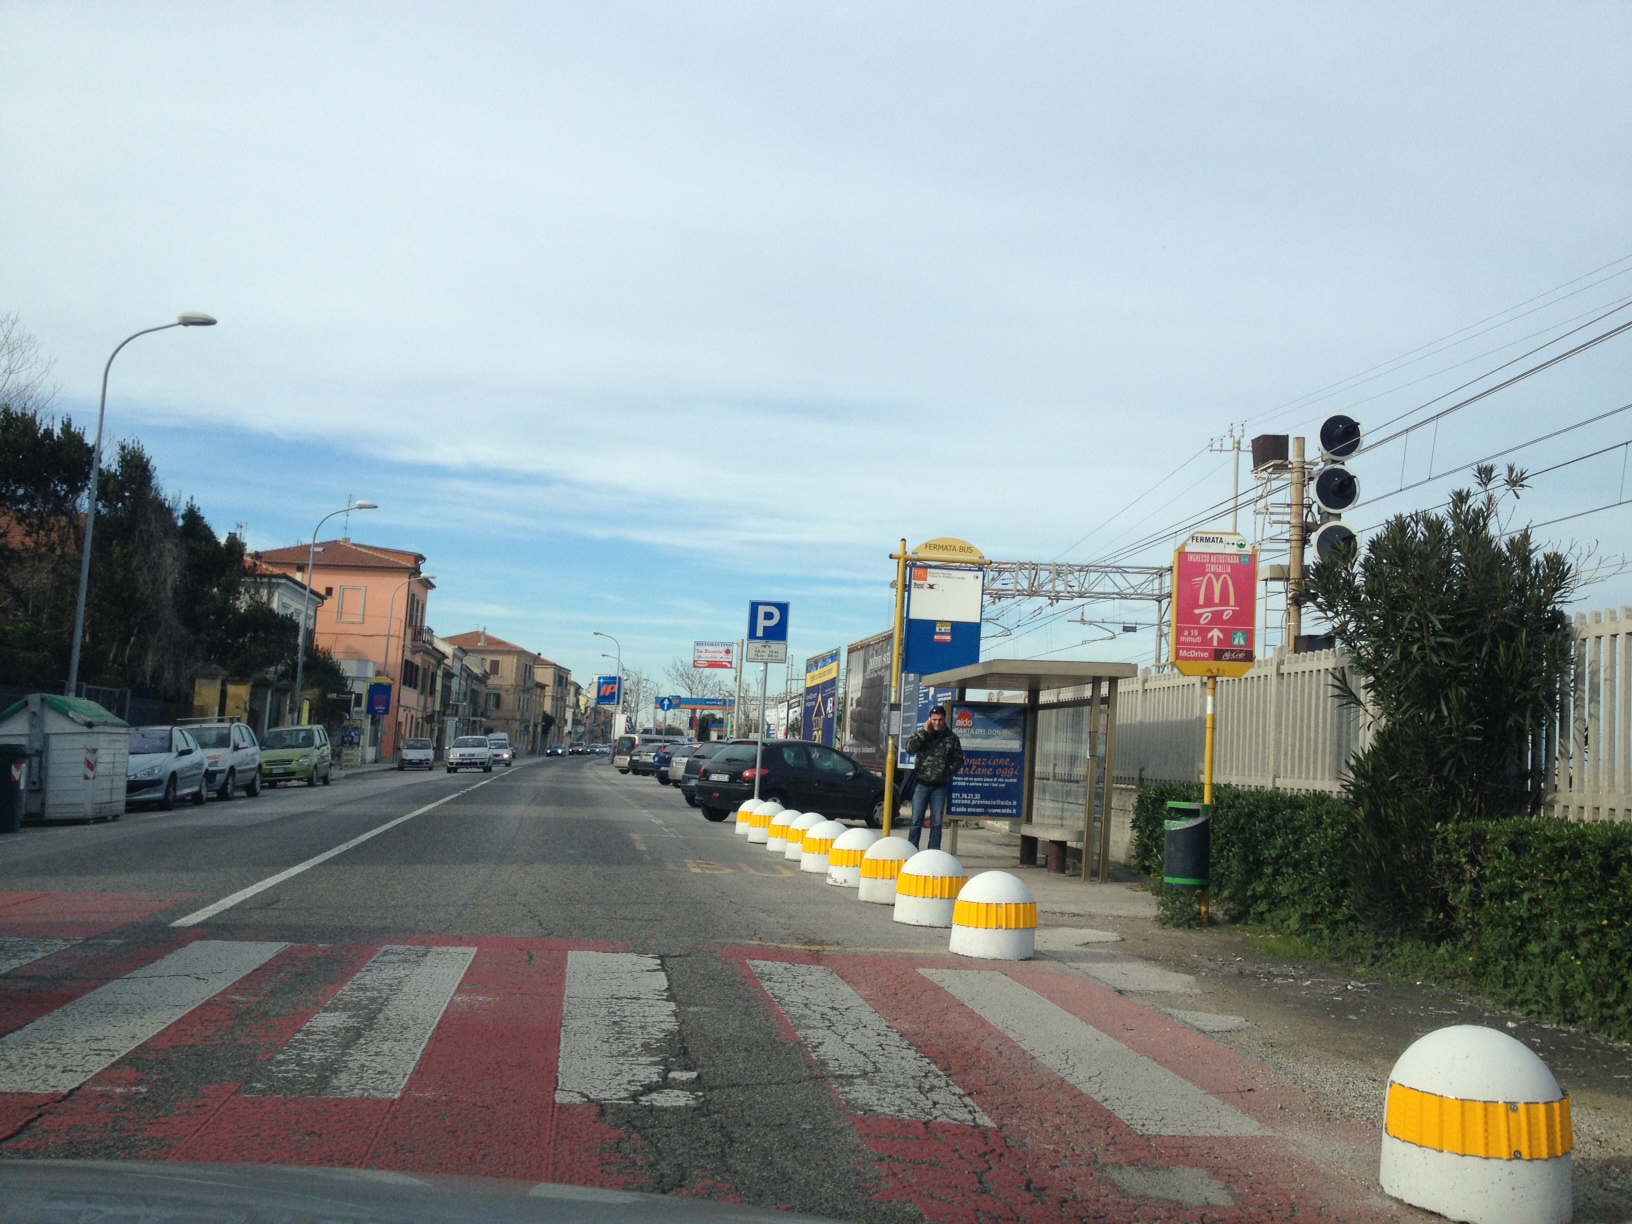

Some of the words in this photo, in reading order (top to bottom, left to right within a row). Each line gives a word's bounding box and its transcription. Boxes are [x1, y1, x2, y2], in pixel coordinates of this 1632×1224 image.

[1191, 536, 1224, 544] FERMATA
[924, 543, 957, 552] FERMATA
[959, 545, 973, 553] BUS
[1187, 554, 1210, 562] INGRESSO
[1210, 554, 1239, 563] AUTOSTRADA
[1205, 564, 1231, 572] SENIGALLIA
[756, 605, 780, 637] P
[1179, 650, 1209, 658] McDrive
[600, 684, 617, 696] IP
[956, 718, 973, 727] aido
[963, 757, 1015, 767] onazione,
[957, 765, 993, 775] arlane
[996, 765, 1020, 777] oggi
